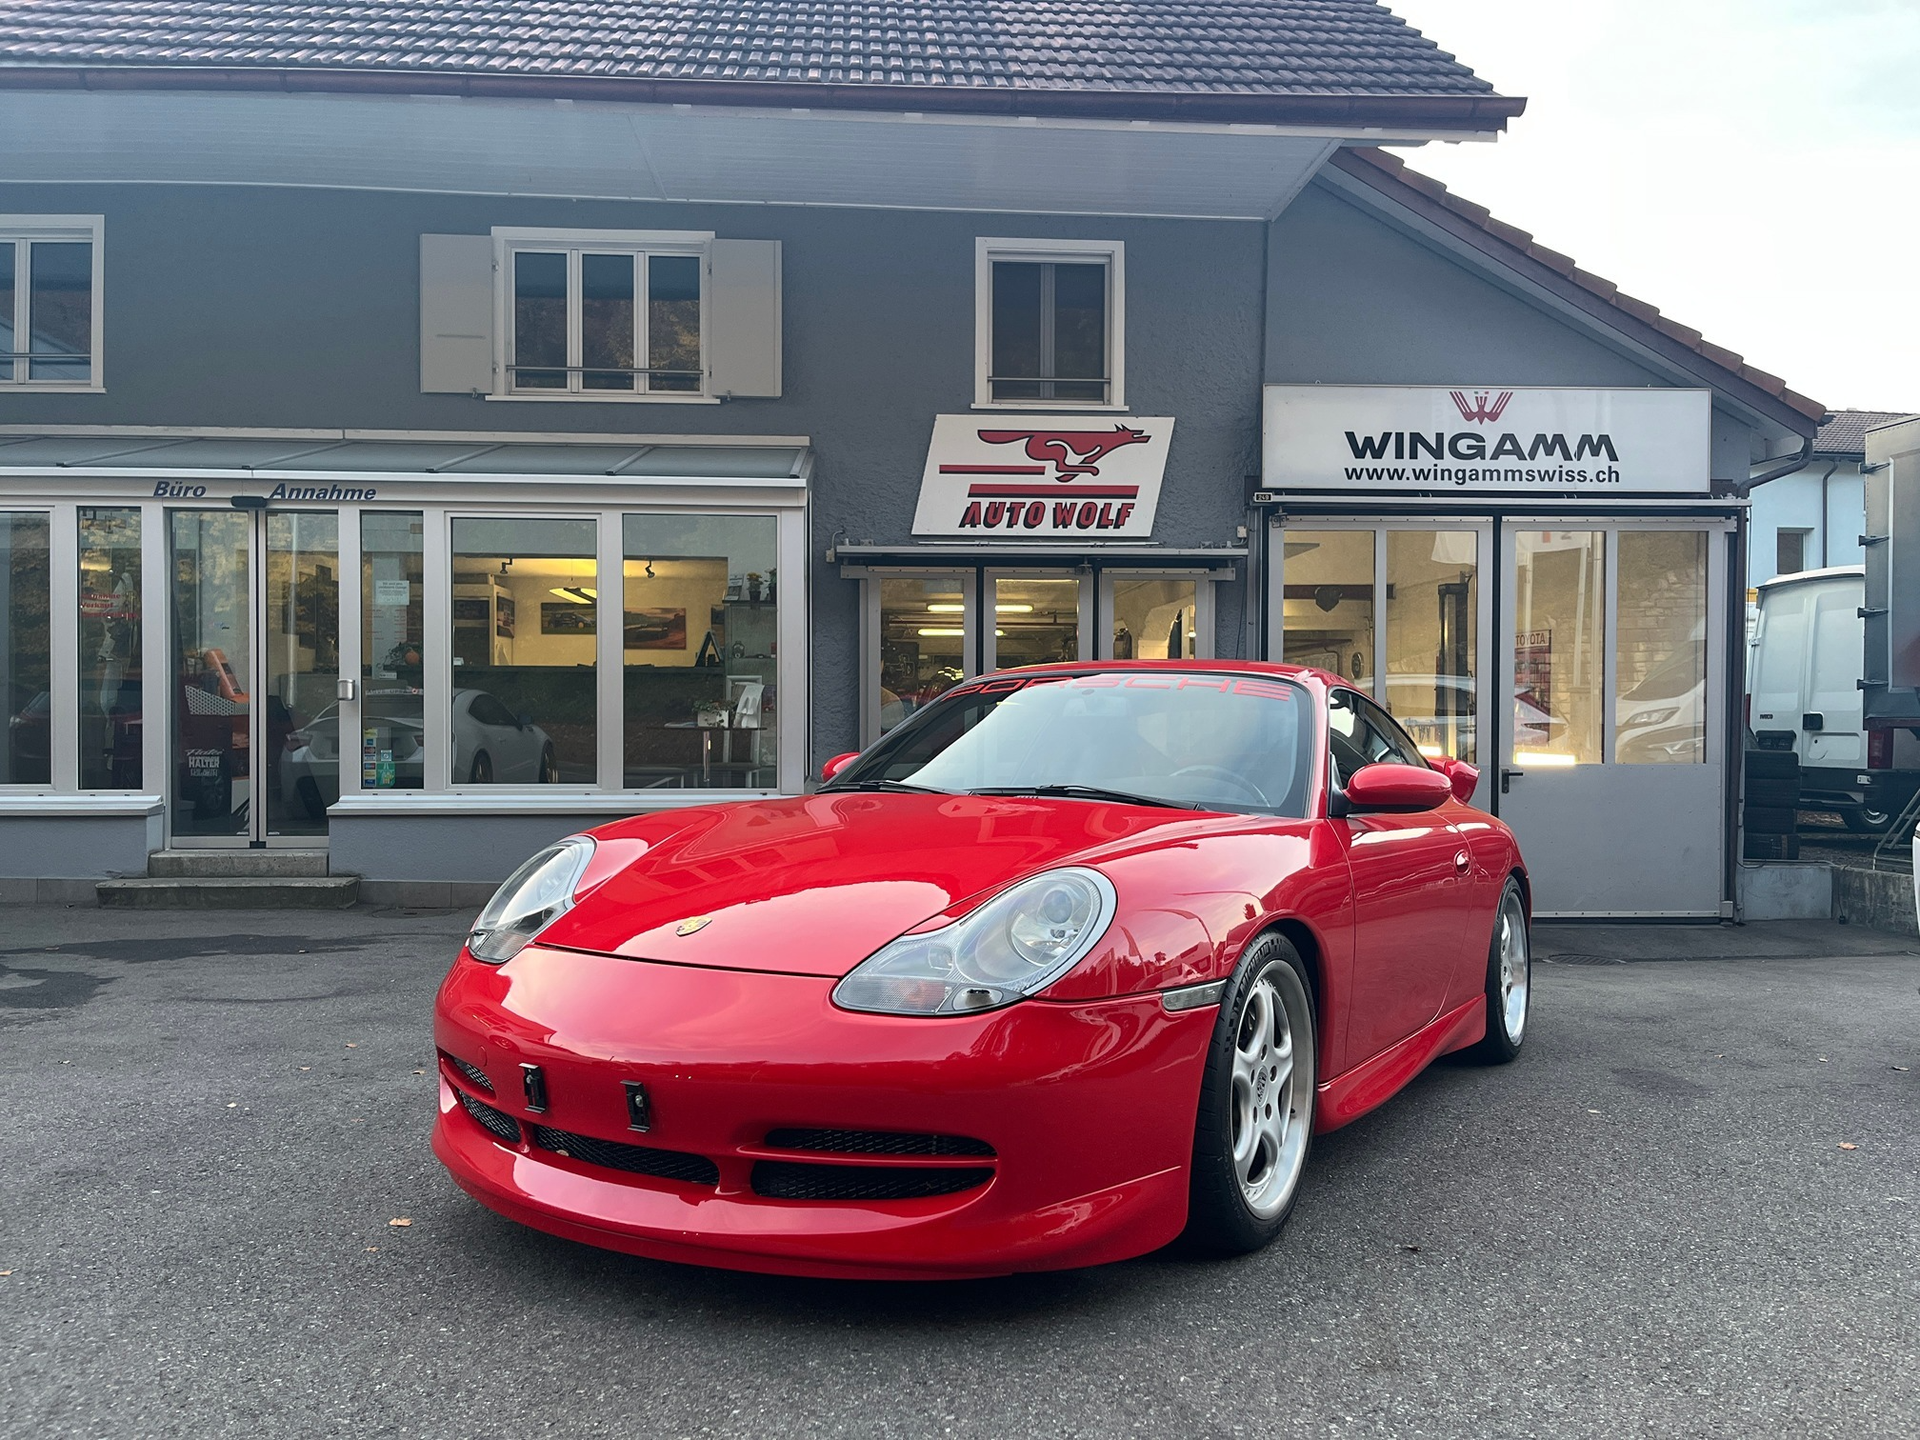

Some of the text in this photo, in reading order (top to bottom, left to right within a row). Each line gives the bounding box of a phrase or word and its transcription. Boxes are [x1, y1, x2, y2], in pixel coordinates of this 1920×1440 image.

[1344, 431, 1619, 462] WINGAMM
[1344, 464, 1620, 486] www.wingammswiss.ch
[153, 481, 377, 501] Büro Annahme
[958, 501, 1136, 530] AUTO WOLF
[1515, 632, 1547, 647] TOYOTA
[942, 675, 1293, 702] PORSCHE
[188, 755, 220, 768] HALTER
